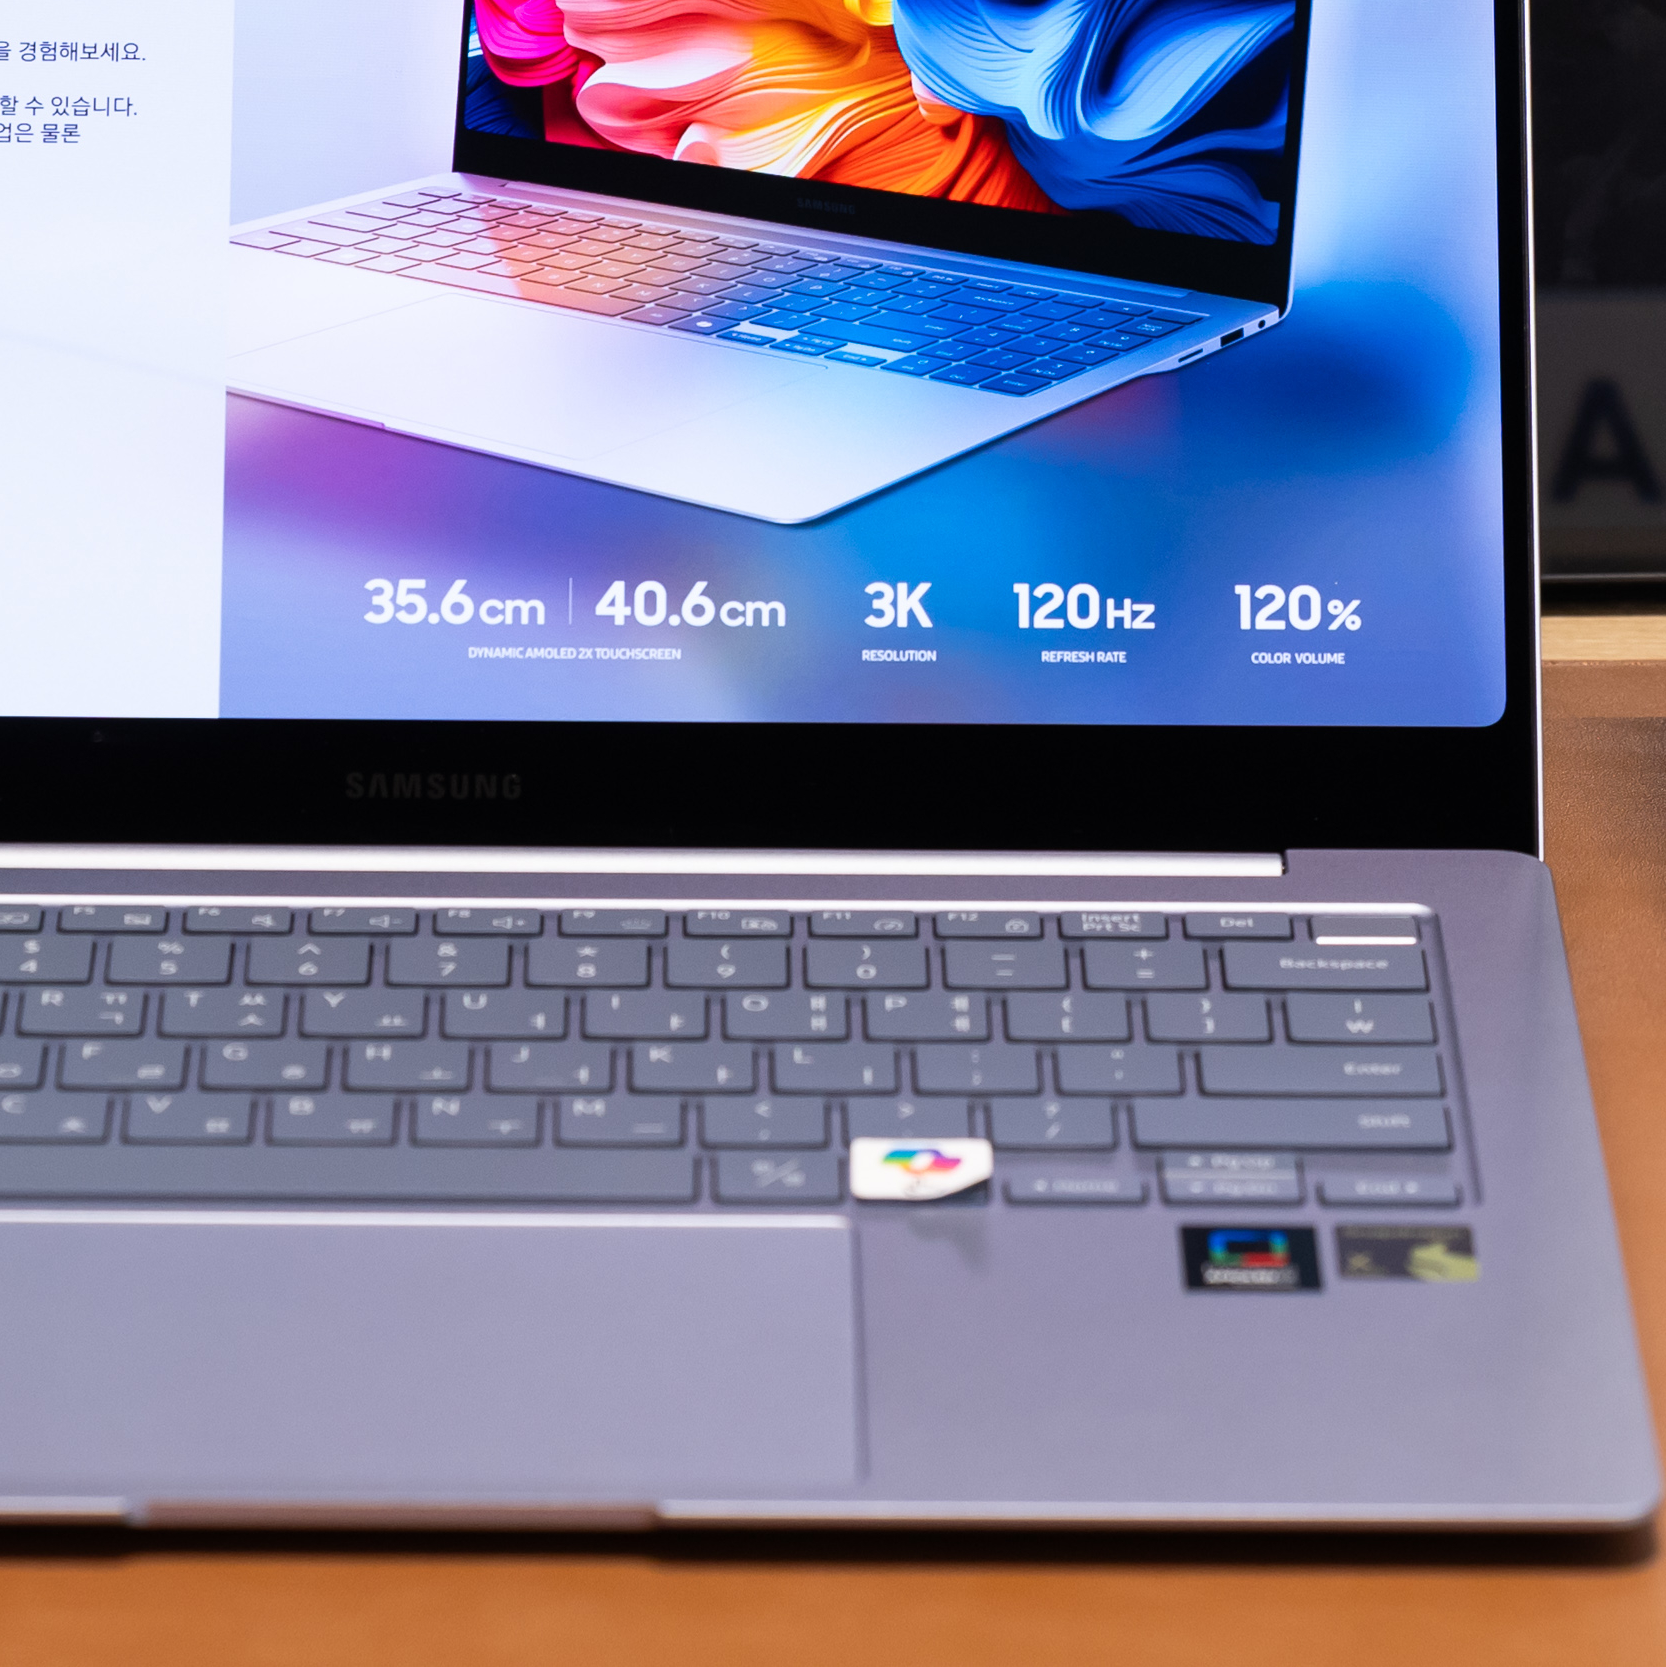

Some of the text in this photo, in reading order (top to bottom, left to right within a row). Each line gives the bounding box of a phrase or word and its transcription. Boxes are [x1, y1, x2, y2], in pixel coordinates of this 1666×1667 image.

[20, 41, 145, 63] 경험해보세요.
[25, 96, 44, 116] 수
[51, 96, 137, 117] 있습니다.
[41, 123, 80, 144] 물론
[865, 582, 933, 628] 3K
[468, 647, 681, 661] DYNAMIC AMOLED 2X TOUCHSCREEN
[862, 649, 937, 662] RESOLUTION
[1041, 652, 1127, 664] REFRESH RATE
[1251, 652, 1345, 664] COLOR VOLUME
[345, 772, 522, 799] SAMSUNG
[1081, 913, 1140, 923] Insert
[1220, 917, 1254, 928] Del
[1083, 923, 1142, 932] Prt Sc
[1279, 957, 1389, 971] Backspace
